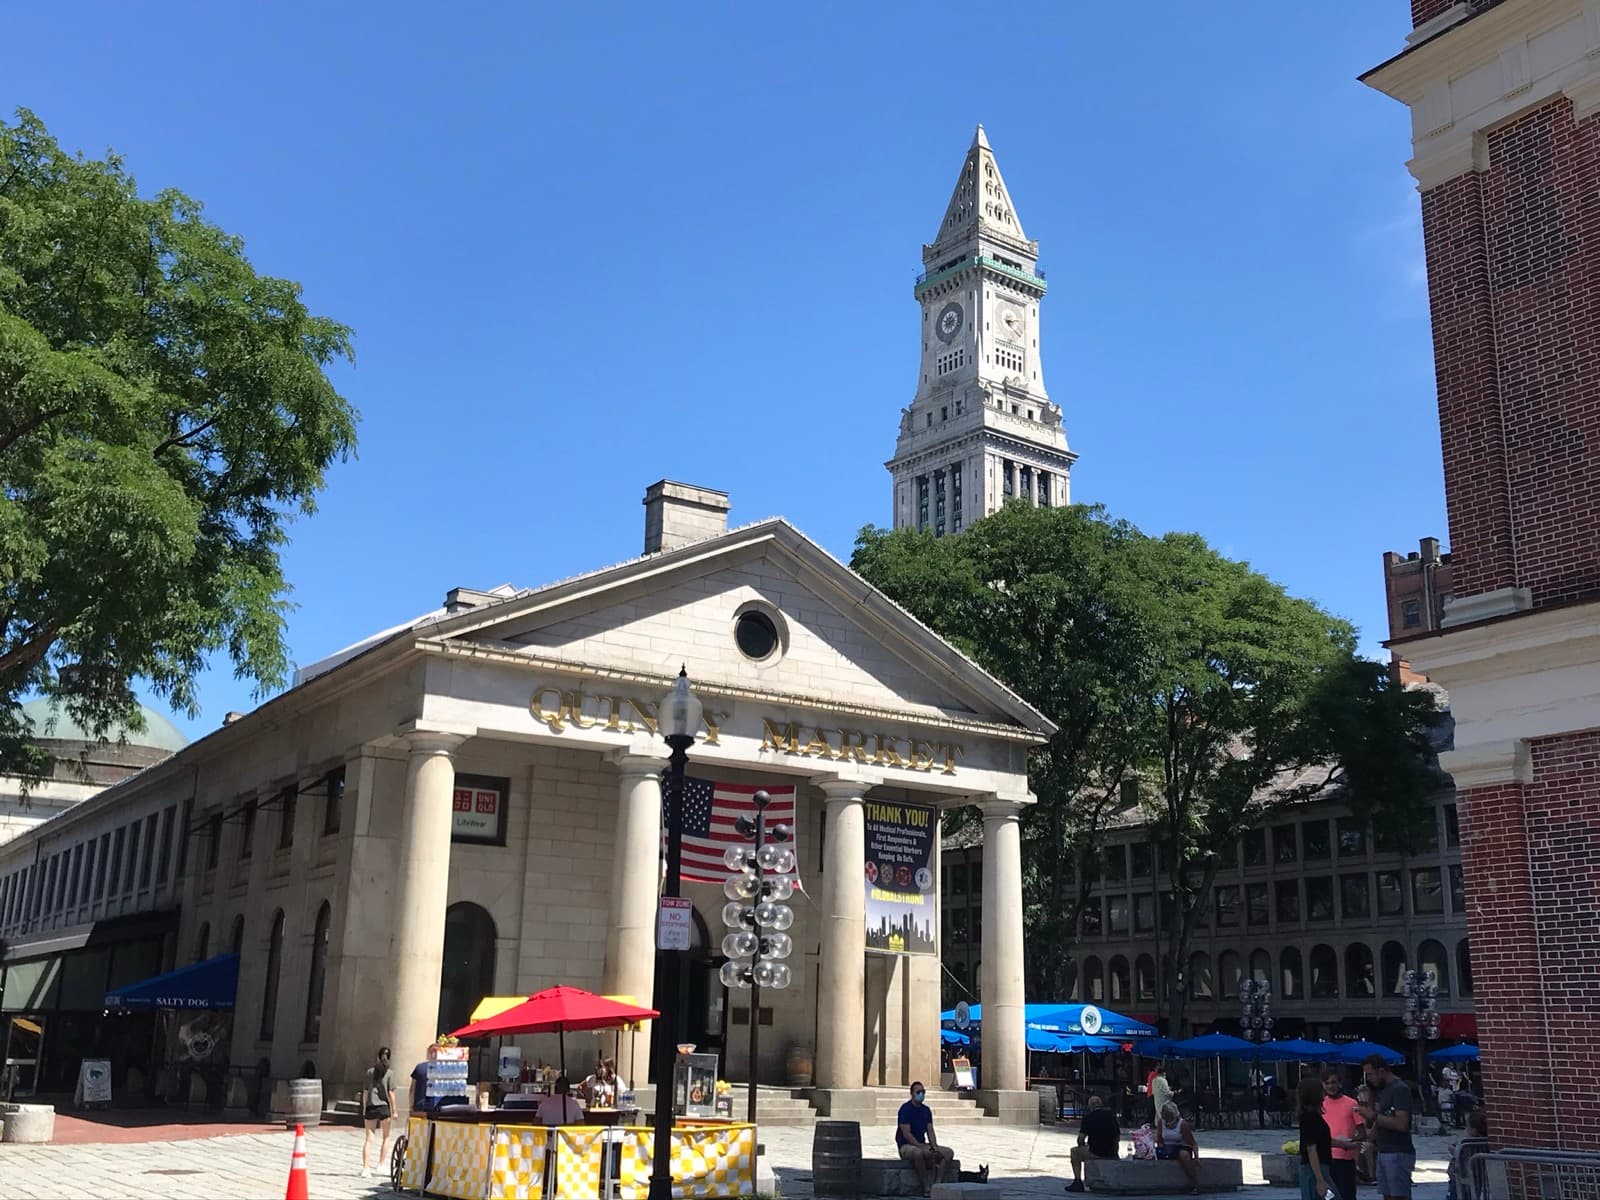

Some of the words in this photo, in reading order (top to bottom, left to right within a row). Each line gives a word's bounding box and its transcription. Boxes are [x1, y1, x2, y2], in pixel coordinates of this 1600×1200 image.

[530, 686, 730, 747] QUINY
[759, 717, 965, 776] MARKET
[866, 803, 902, 824] THANK
[905, 808, 929, 828] YOU!
[880, 824, 897, 834] Medical
[876, 833, 887, 842] First
[888, 834, 912, 845] Responders
[871, 841, 883, 850] Other
[884, 843, 904, 853] Essential
[904, 846, 922, 855] Workers
[878, 851, 896, 863] Keeping
[669, 912, 682, 921] NO
[156, 996, 186, 1007] SALTY
[187, 998, 209, 1007] DOG
